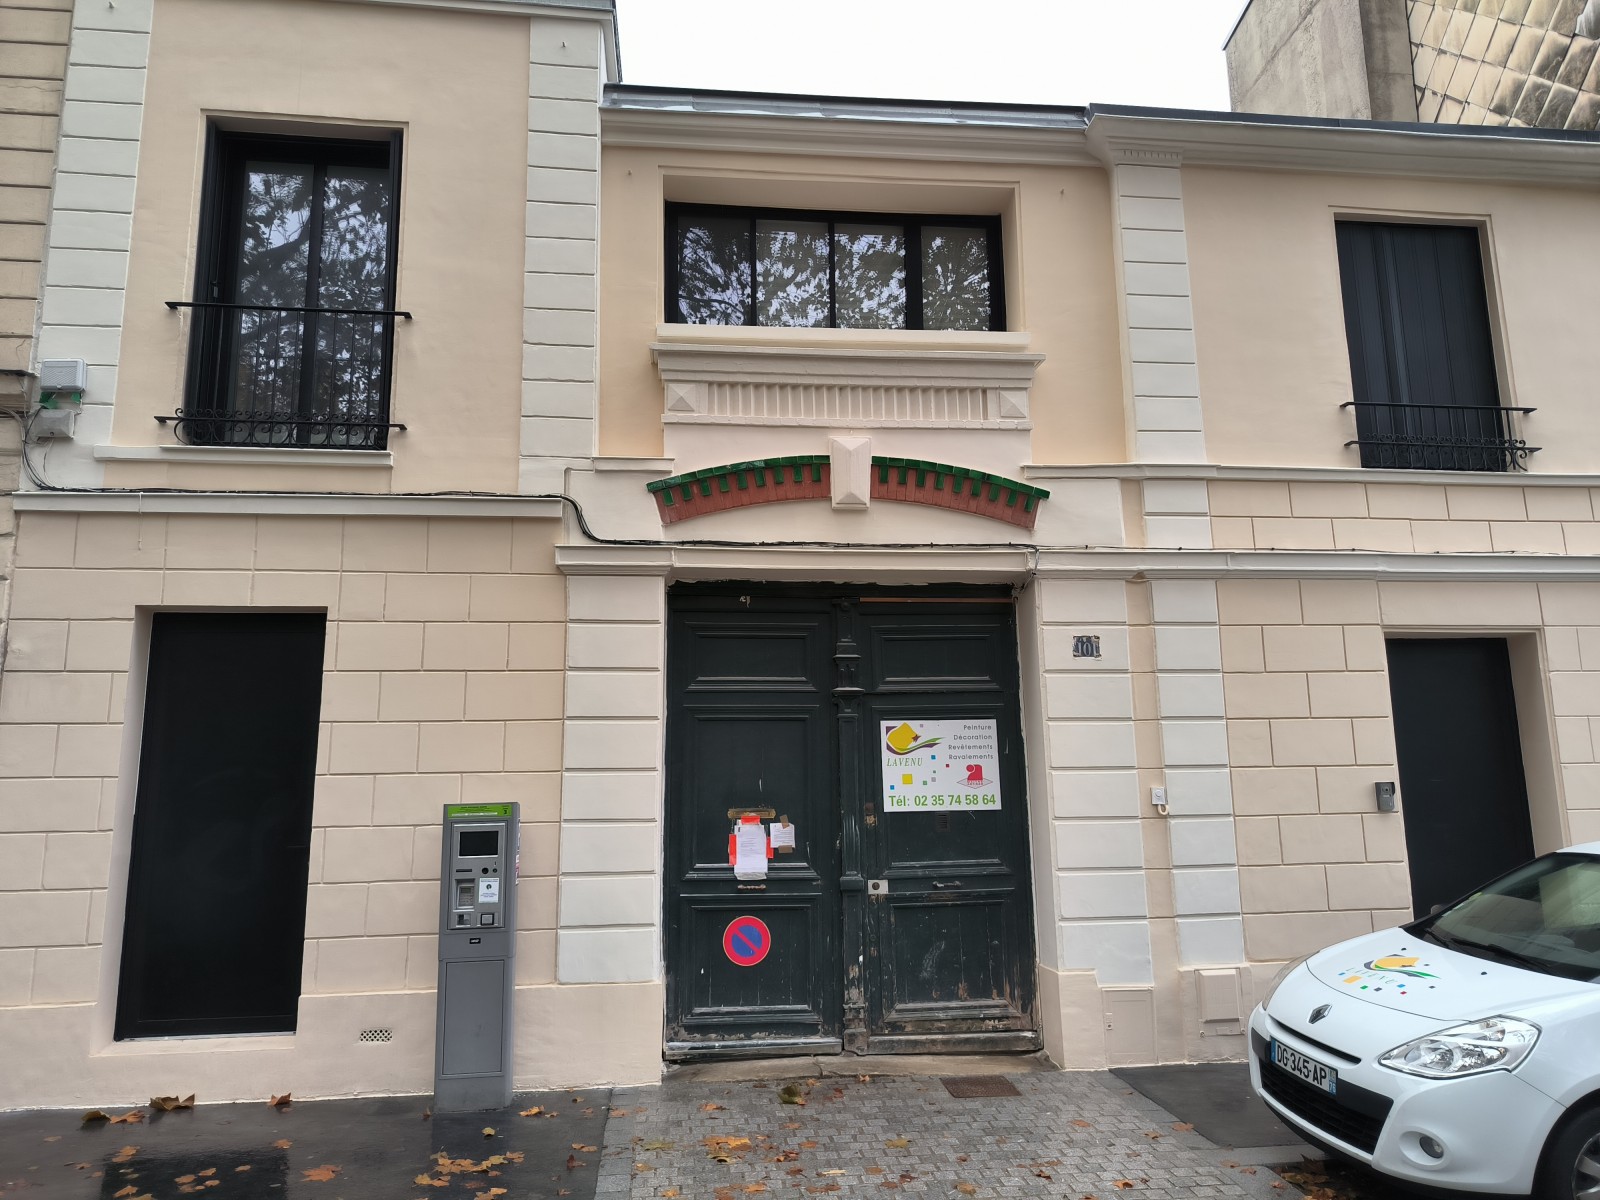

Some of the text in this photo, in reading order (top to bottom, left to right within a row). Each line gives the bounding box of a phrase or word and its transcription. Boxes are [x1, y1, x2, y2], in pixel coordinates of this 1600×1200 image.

[1077, 642, 1099, 657] 101
[886, 758, 923, 767] LAVENU
[914, 795, 928, 806] 02
[931, 794, 945, 806] 35
[947, 794, 962, 806] 74
[965, 794, 979, 805] 58
[982, 793, 997, 805] 64
[1277, 1043, 1327, 1086] DG-345-AP
